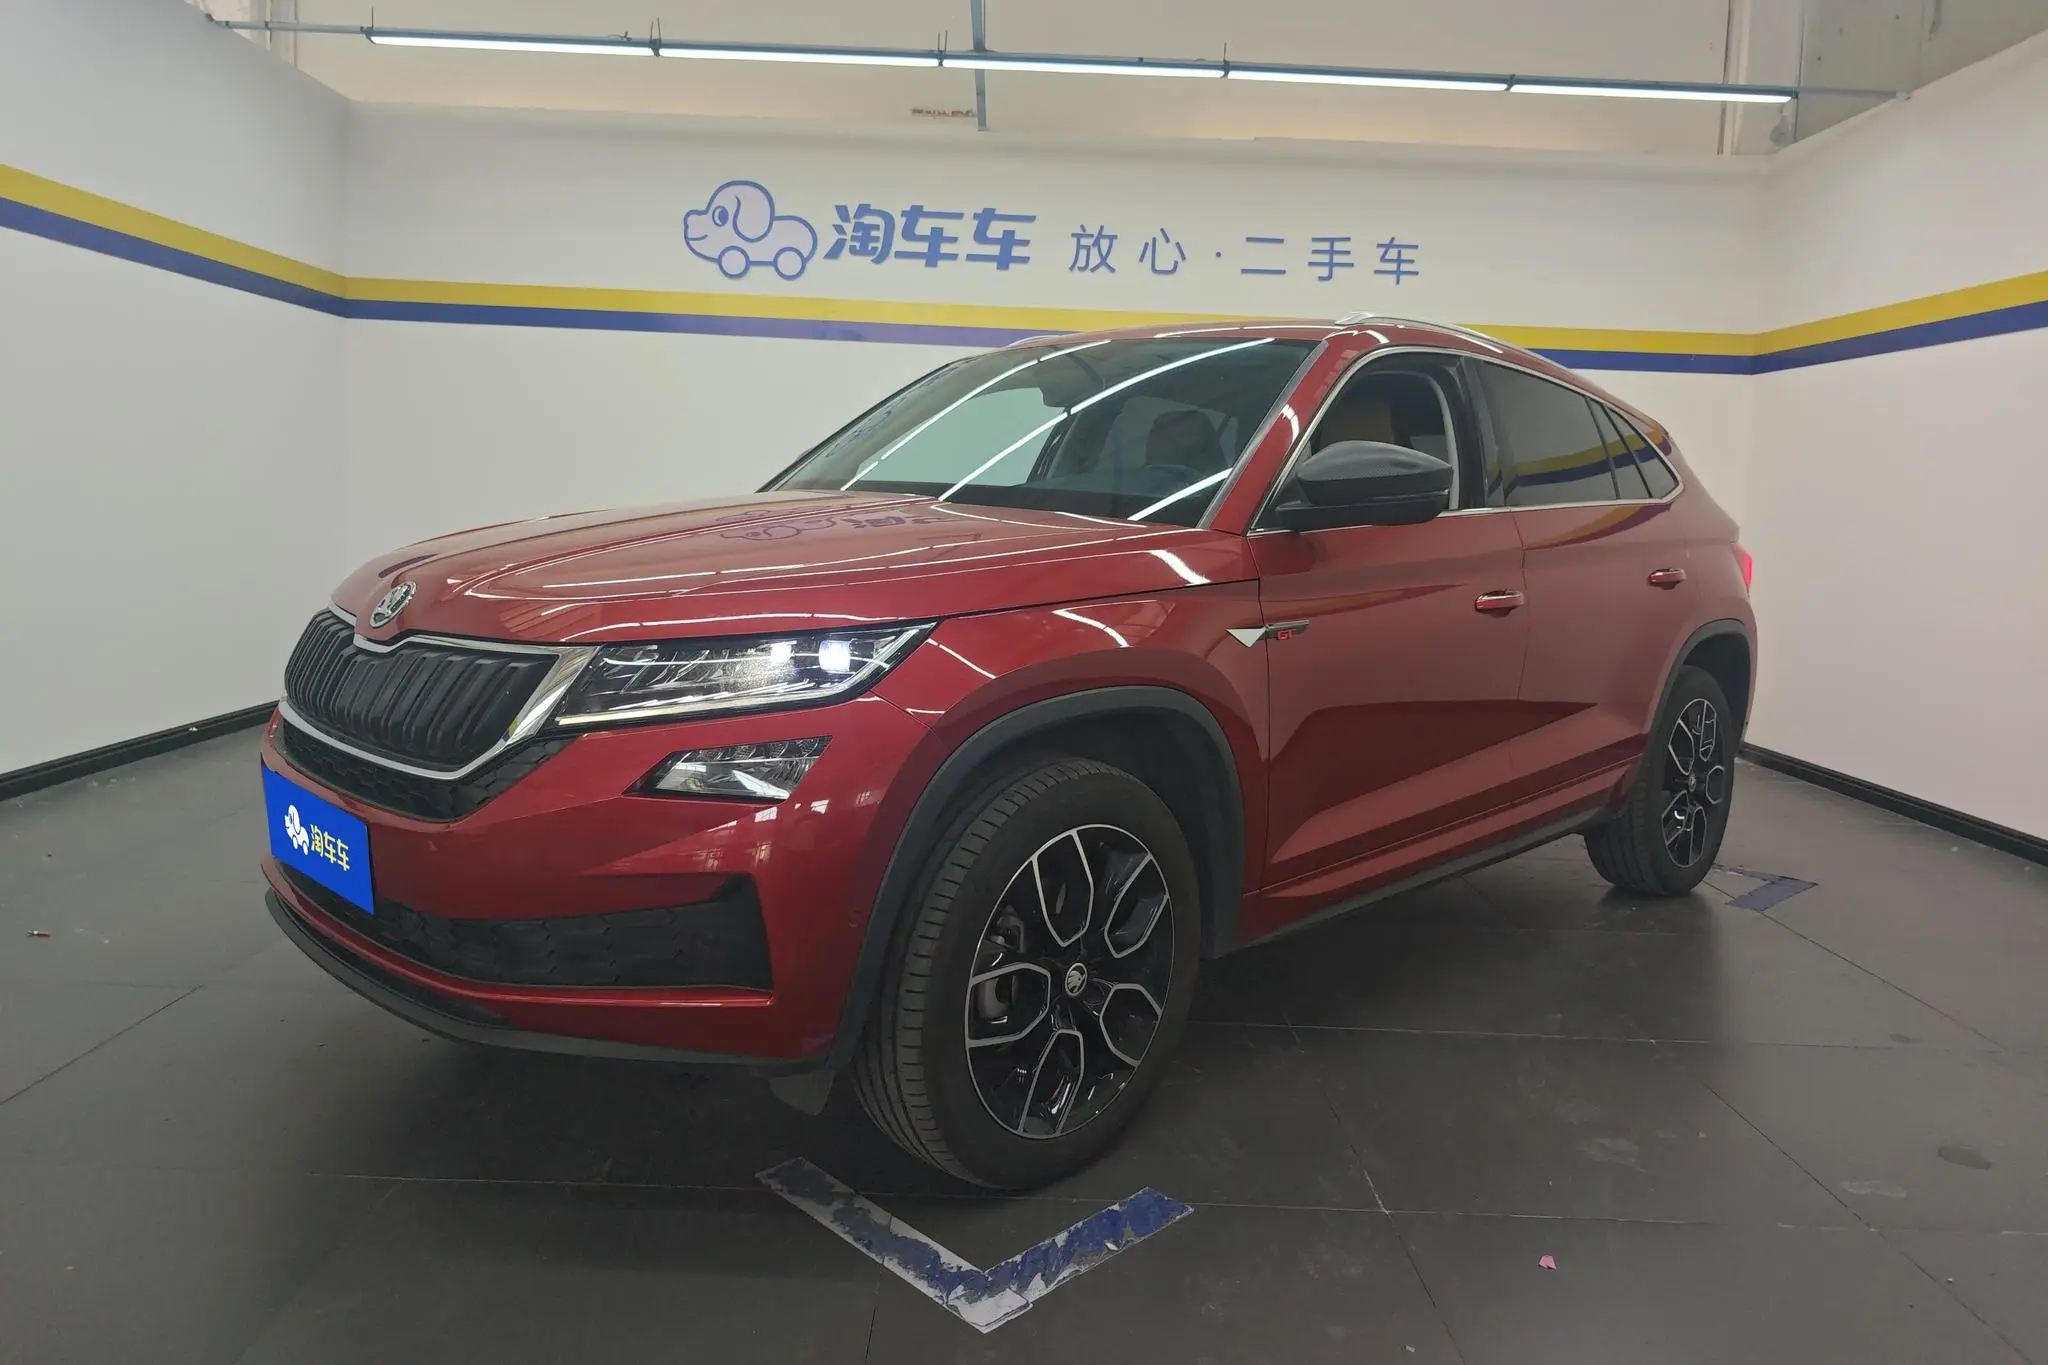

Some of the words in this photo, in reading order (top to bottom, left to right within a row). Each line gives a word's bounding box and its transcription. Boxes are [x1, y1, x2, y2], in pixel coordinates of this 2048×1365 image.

[823, 203, 1037, 271] 淘车车
[310, 824, 350, 871] 淘车车
